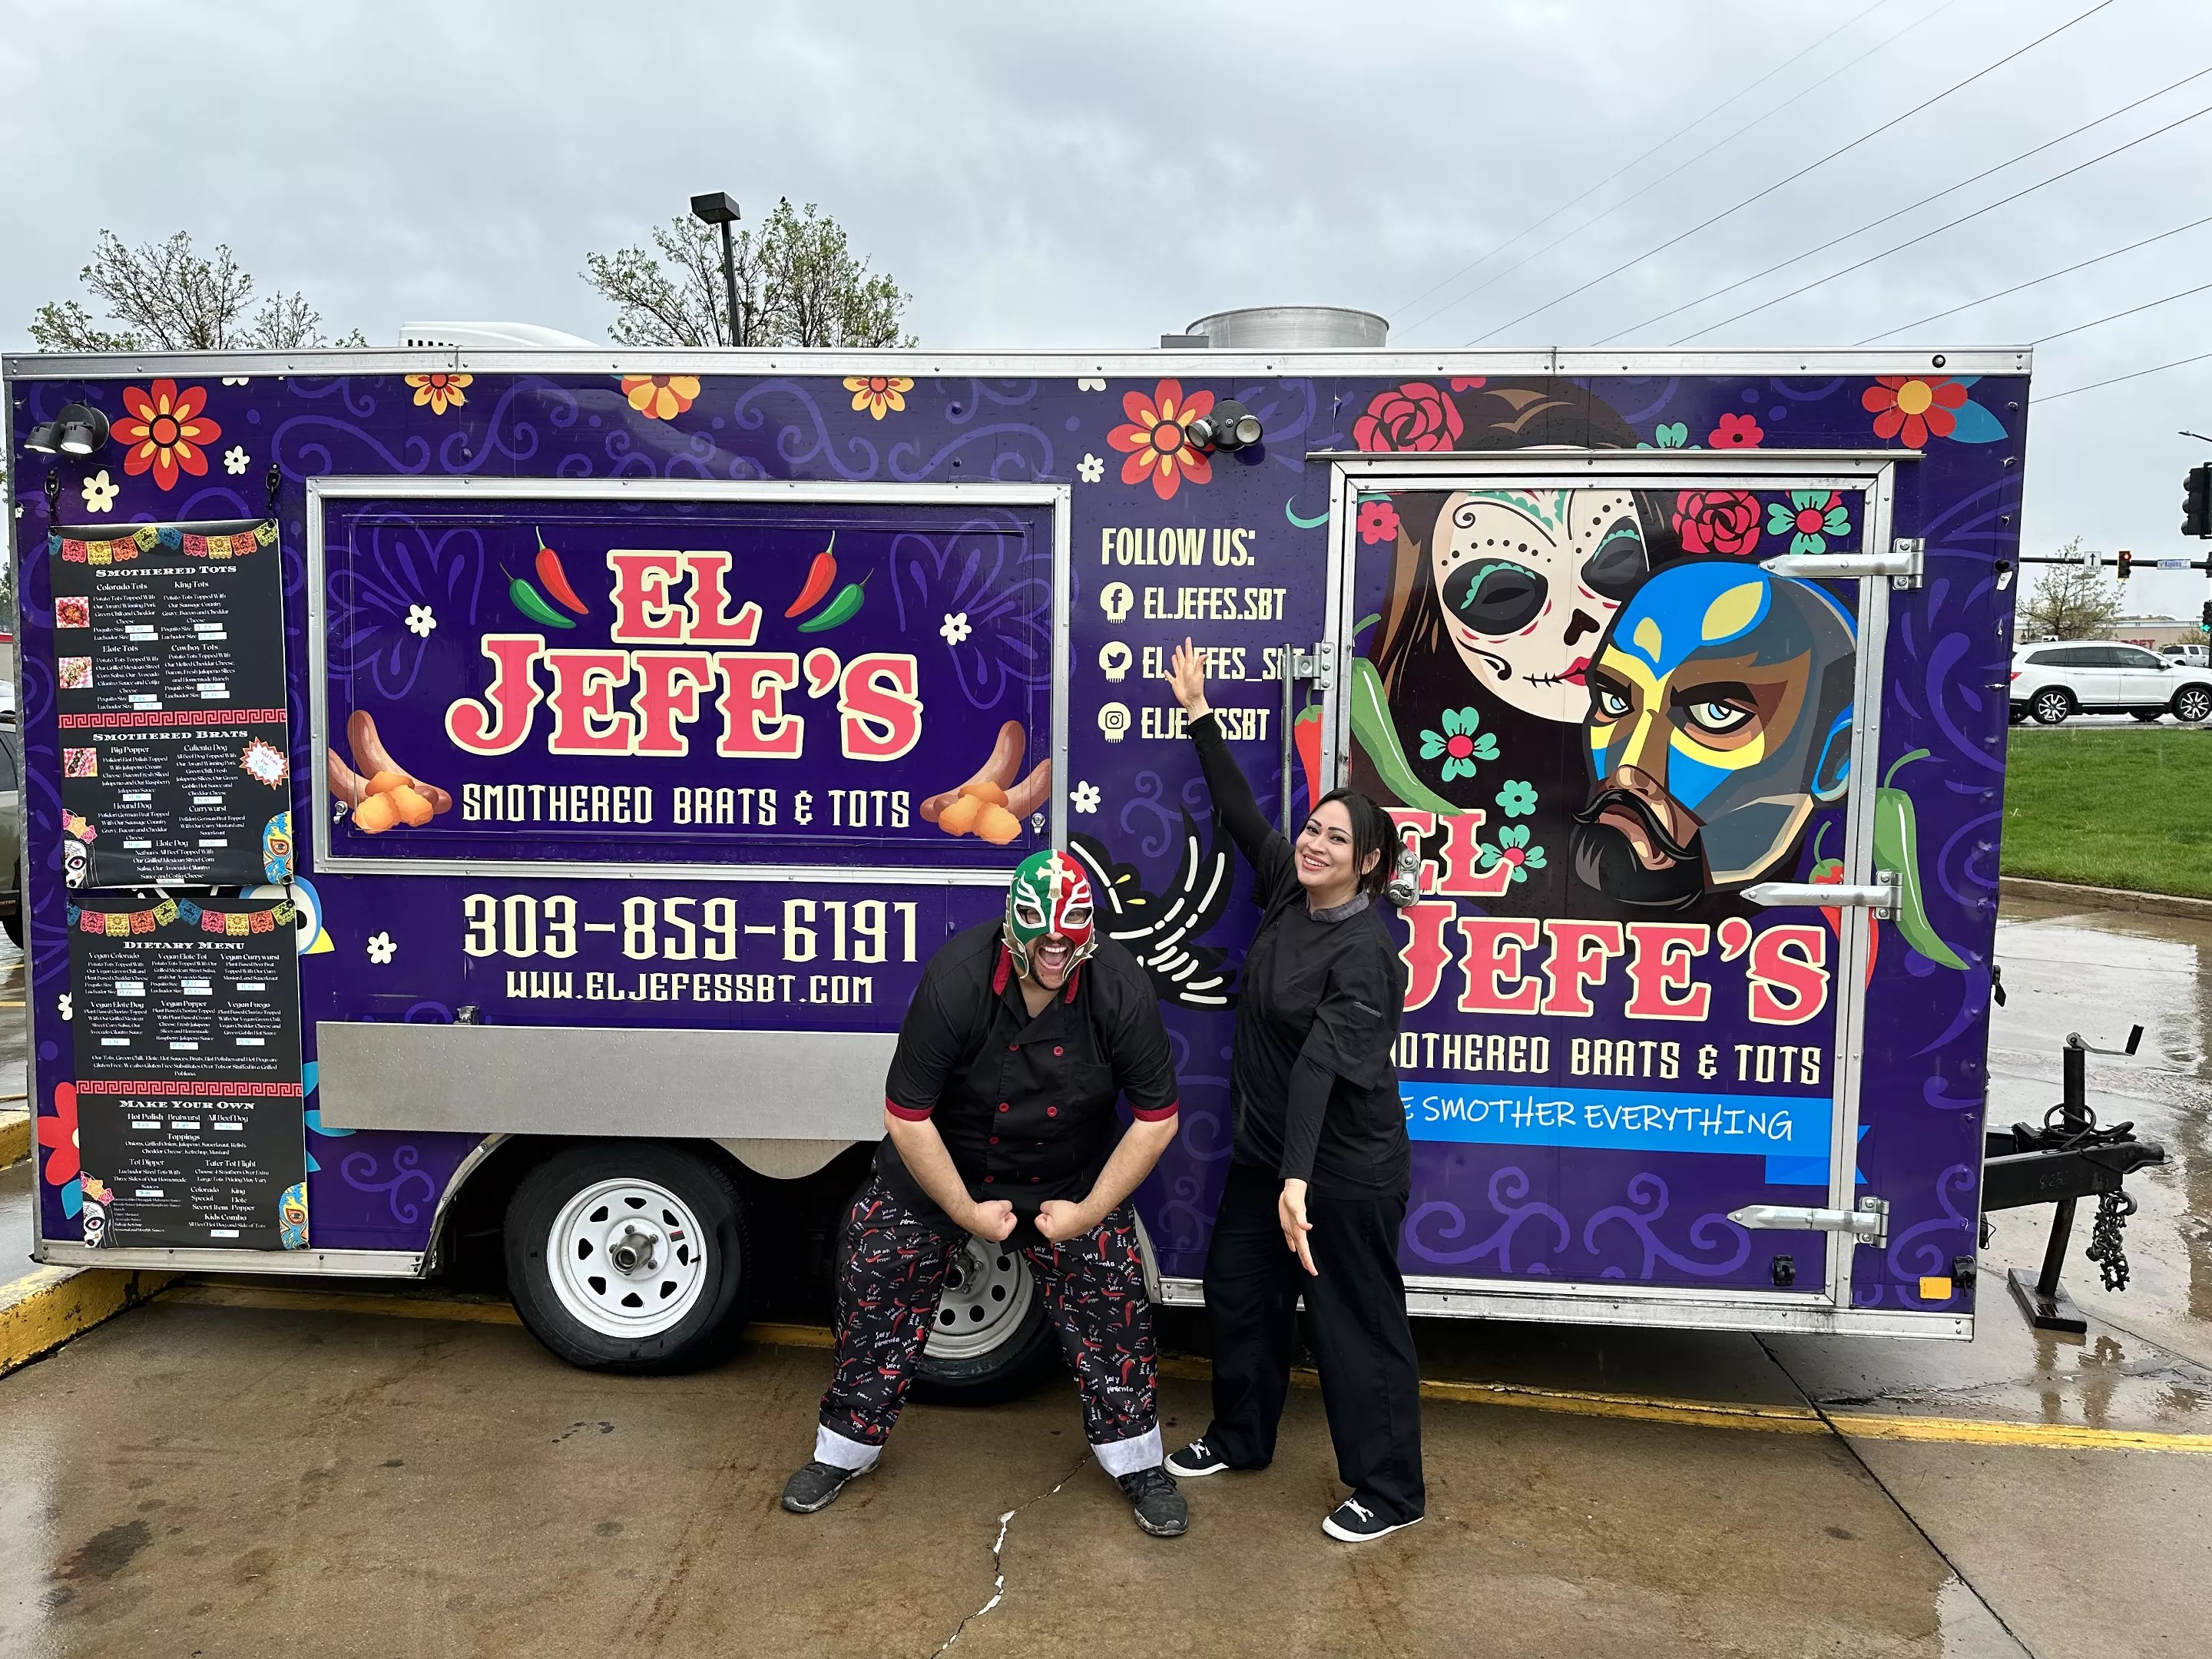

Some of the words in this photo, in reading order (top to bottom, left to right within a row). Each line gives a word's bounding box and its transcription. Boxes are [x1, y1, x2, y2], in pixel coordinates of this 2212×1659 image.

[1101, 527, 1207, 566] FOLLOW
[1212, 527, 1257, 567] US:
[95, 567, 196, 578] SMOTHERED
[199, 565, 237, 574] TOTS
[96, 582, 130, 591] Colorado
[174, 581, 191, 590] King
[606, 549, 762, 646] EL
[1144, 587, 1286, 621] EL.JEFES.SBT
[171, 644, 200, 652] Cowboy
[445, 632, 924, 762] JEFE'S
[92, 732, 192, 741] SMOTHERED
[195, 730, 248, 739] BRATS
[111, 746, 123, 754] Big
[124, 746, 150, 754] Popper
[213, 743, 227, 752] Dog
[188, 805, 227, 813] Currywurst
[462, 783, 653, 825] SMOTHERED
[673, 786, 777, 826] BRATS
[793, 790, 813, 826] &
[828, 790, 909, 828] TOTS
[174, 839, 188, 848] Dog
[462, 893, 919, 965] 303-859-6191
[123, 941, 194, 949] DIETARY
[197, 942, 245, 950] MENU
[88, 952, 110, 960] Vegan
[220, 953, 242, 962] Vegan
[1397, 900, 1830, 1026] JEFE'S
[505, 970, 873, 1005] WWW.ELJEFESSBT.COM
[183, 1000, 207, 1008] Popper
[227, 1001, 250, 1009] Vegan
[250, 1001, 271, 1009] Fuego
[1389, 1031, 1550, 1074] OTHERED
[1571, 1038, 1681, 1079] BRATS
[1697, 1044, 1718, 1080] &
[1734, 1044, 1821, 1085] TOTS
[118, 1100, 168, 1108] MAKE
[171, 1101, 214, 1109] YOUR
[216, 1101, 255, 1110] OWN
[233, 1114, 248, 1123] Dog
[1401, 1096, 1415, 1120] E
[1422, 1095, 1576, 1128] SMOTHER
[1584, 1104, 1793, 1141] EVERYTHING
[167, 1133, 200, 1141] Toppings
[141, 1158, 164, 1167] Dipper
[237, 1160, 256, 1168] Flight
